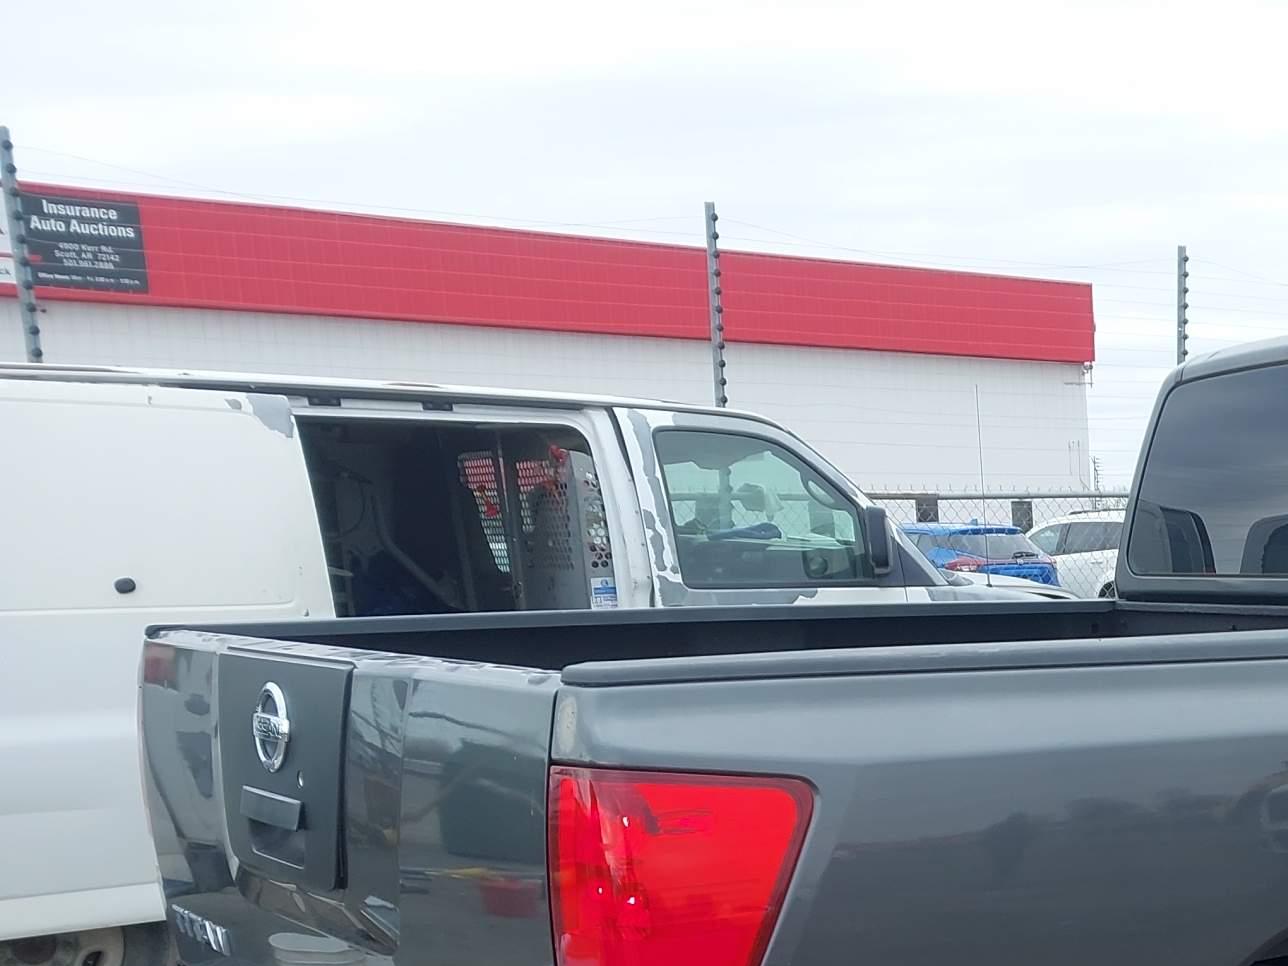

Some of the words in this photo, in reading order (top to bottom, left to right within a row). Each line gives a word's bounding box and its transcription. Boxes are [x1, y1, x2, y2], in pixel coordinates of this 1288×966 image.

[42, 199, 118, 219] Insurance
[30, 215, 66, 231] Auto
[70, 219, 135, 237] Auctions
